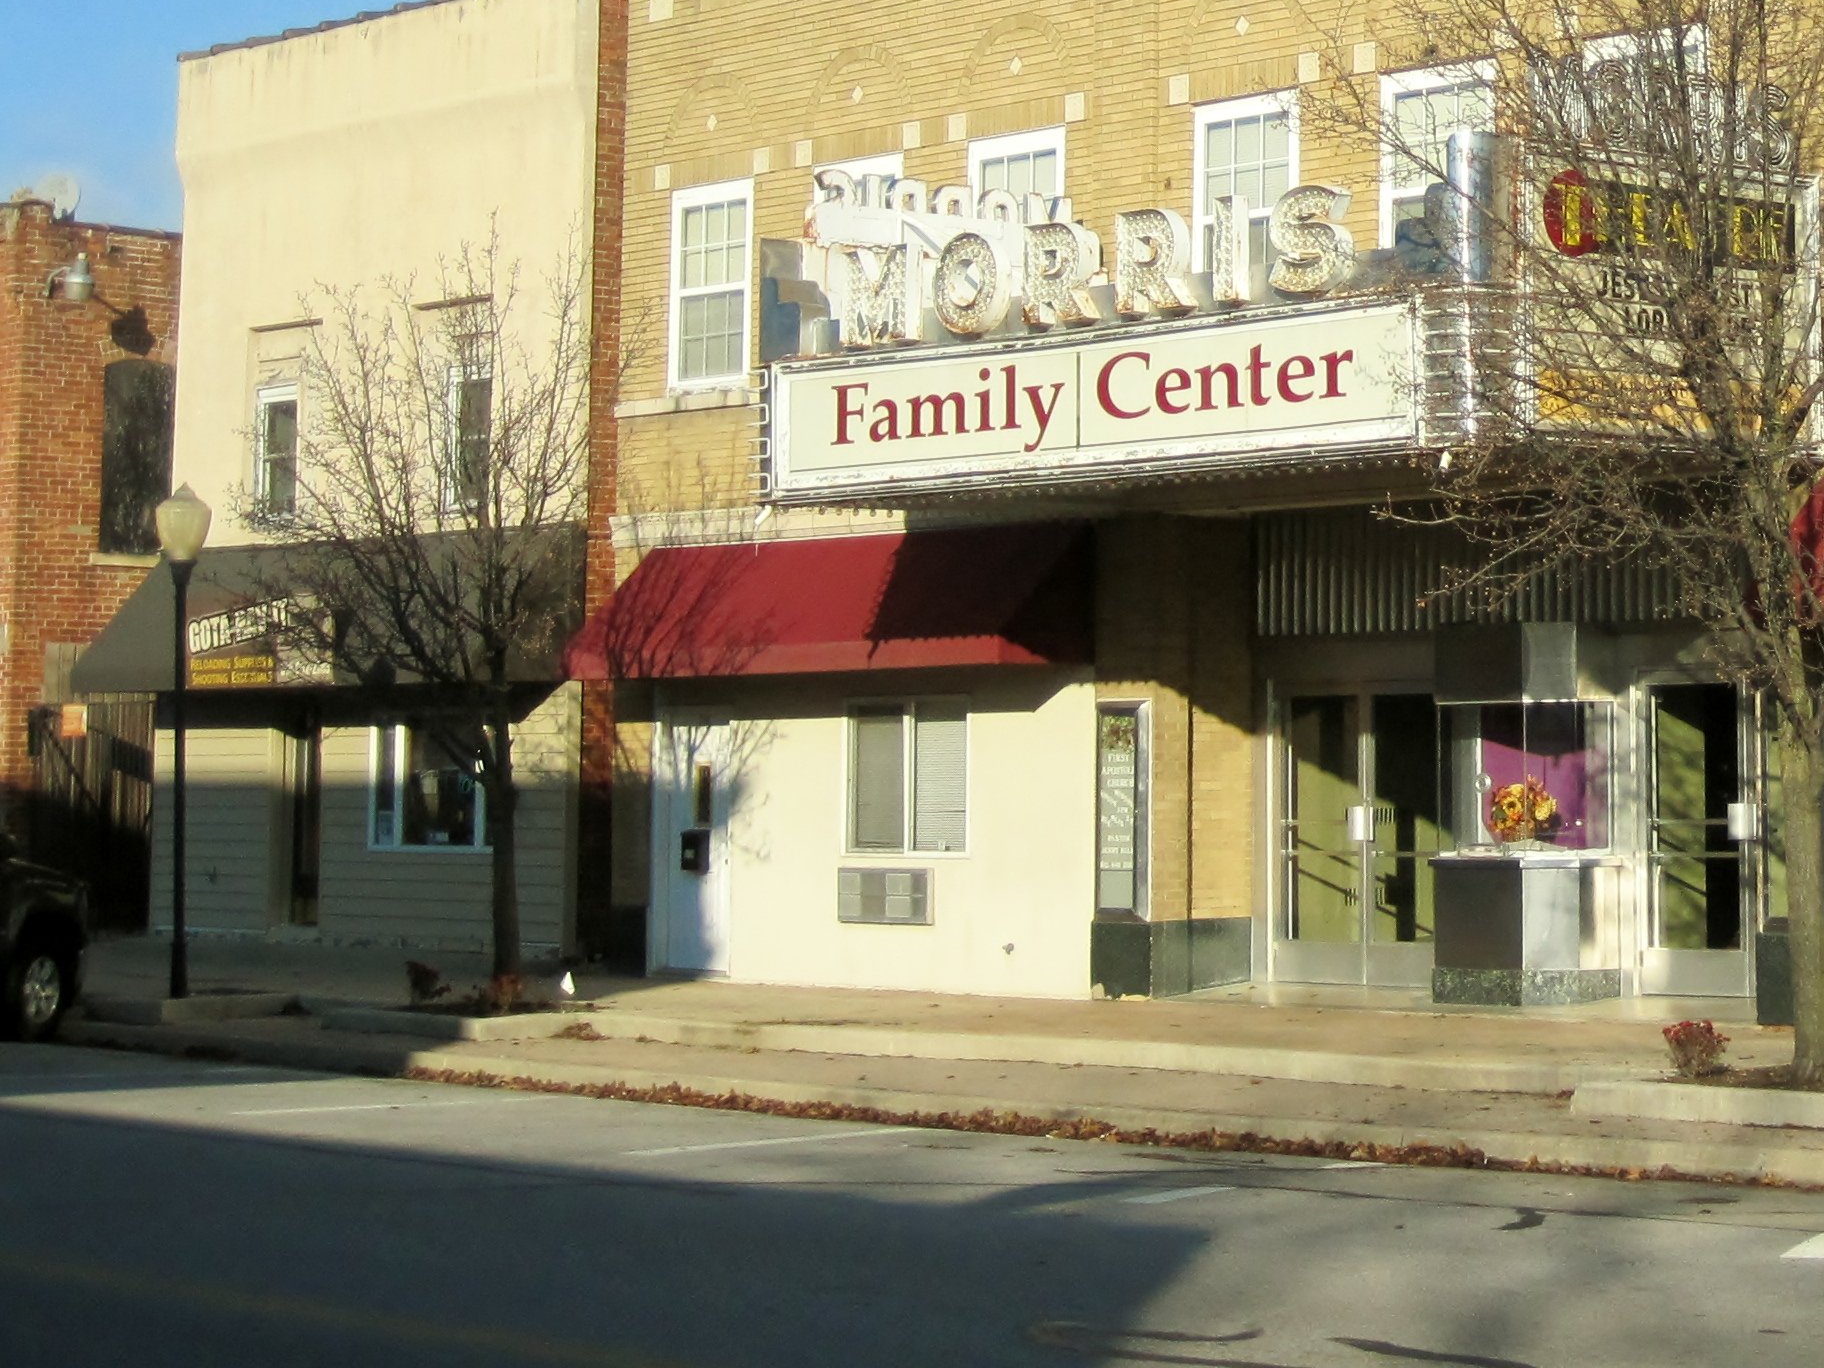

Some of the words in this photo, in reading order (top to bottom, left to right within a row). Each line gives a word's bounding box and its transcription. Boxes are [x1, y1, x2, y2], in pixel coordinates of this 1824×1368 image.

[1528, 50, 1792, 167] MORIS
[840, 184, 1356, 347] MORRIS
[829, 364, 1065, 452] Family
[1096, 343, 1354, 420] Center
